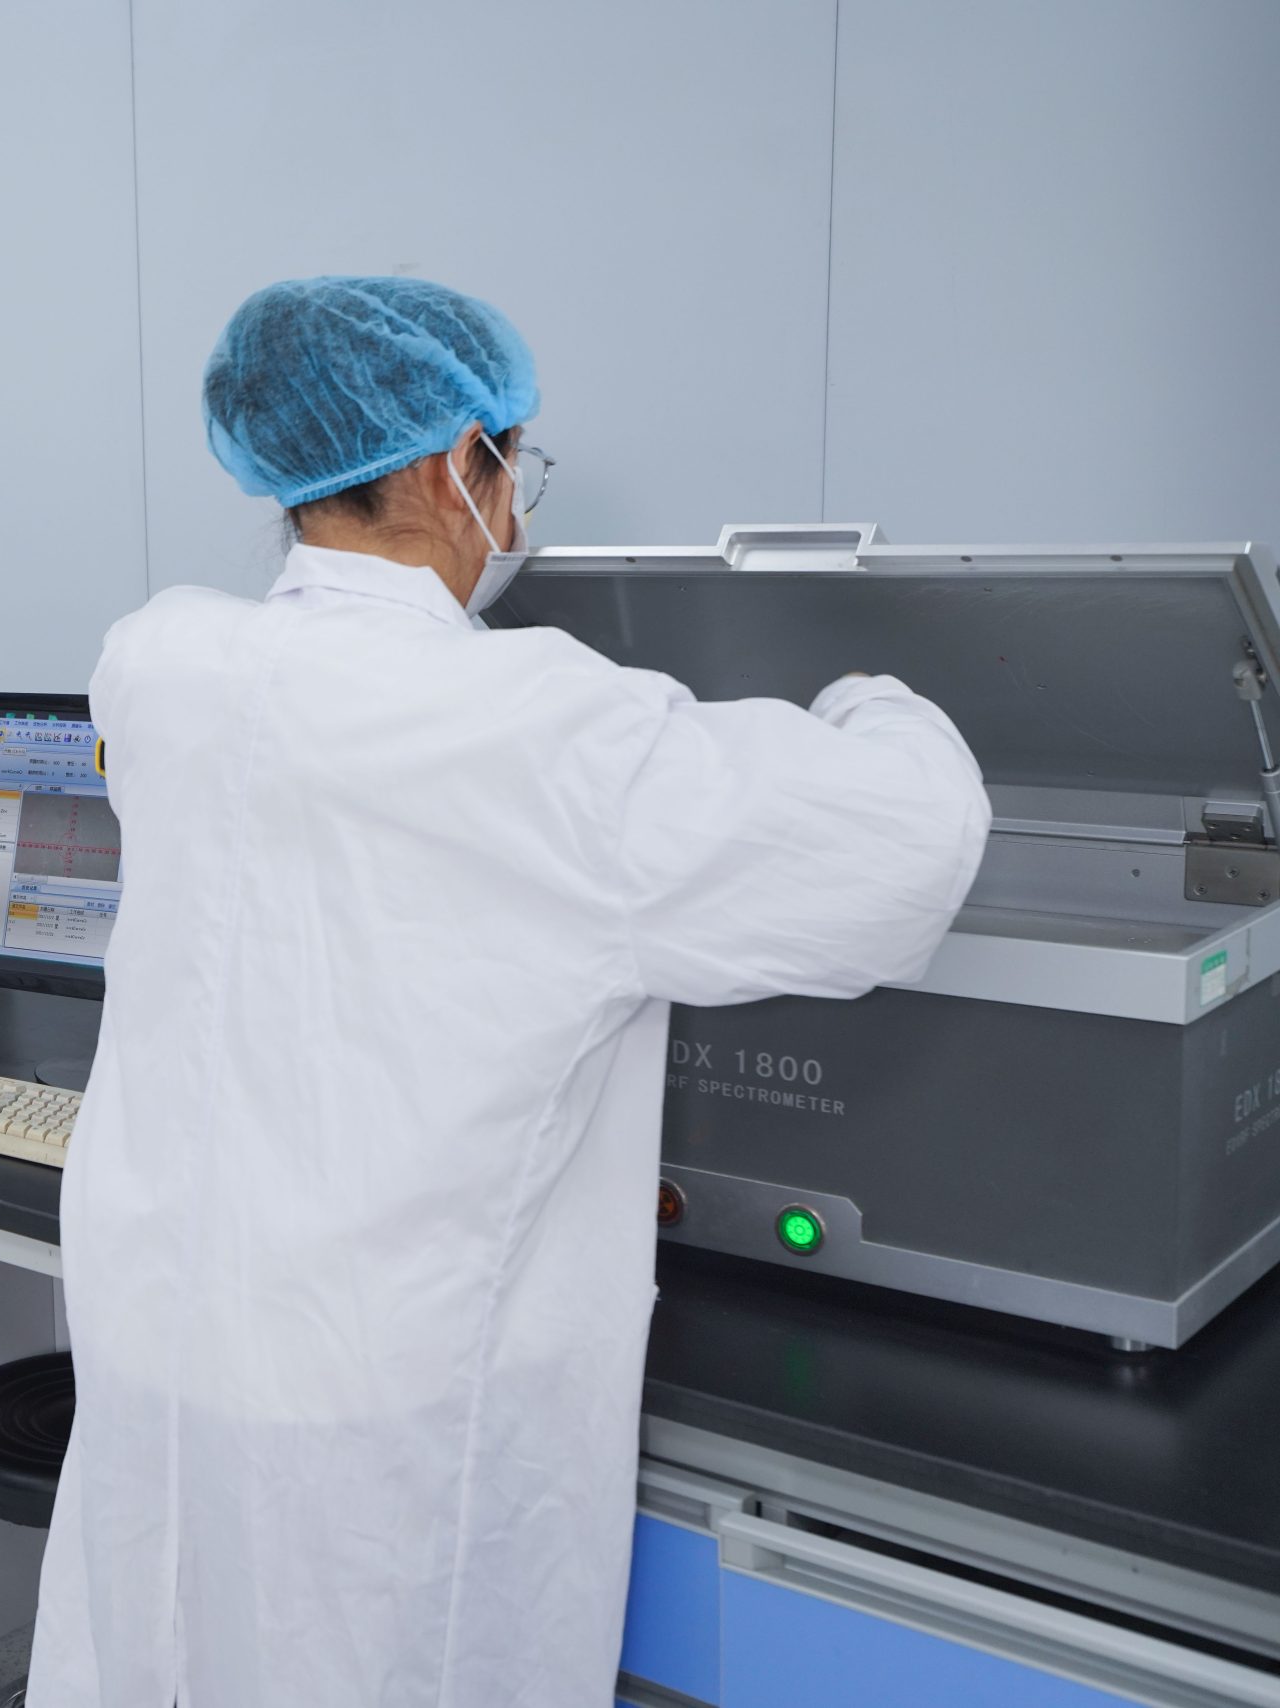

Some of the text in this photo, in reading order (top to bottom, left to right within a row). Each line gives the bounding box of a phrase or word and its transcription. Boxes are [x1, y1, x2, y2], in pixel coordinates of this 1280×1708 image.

[672, 1039, 823, 1086] DX 1800
[697, 1079, 846, 1116] SPECTROMETER
